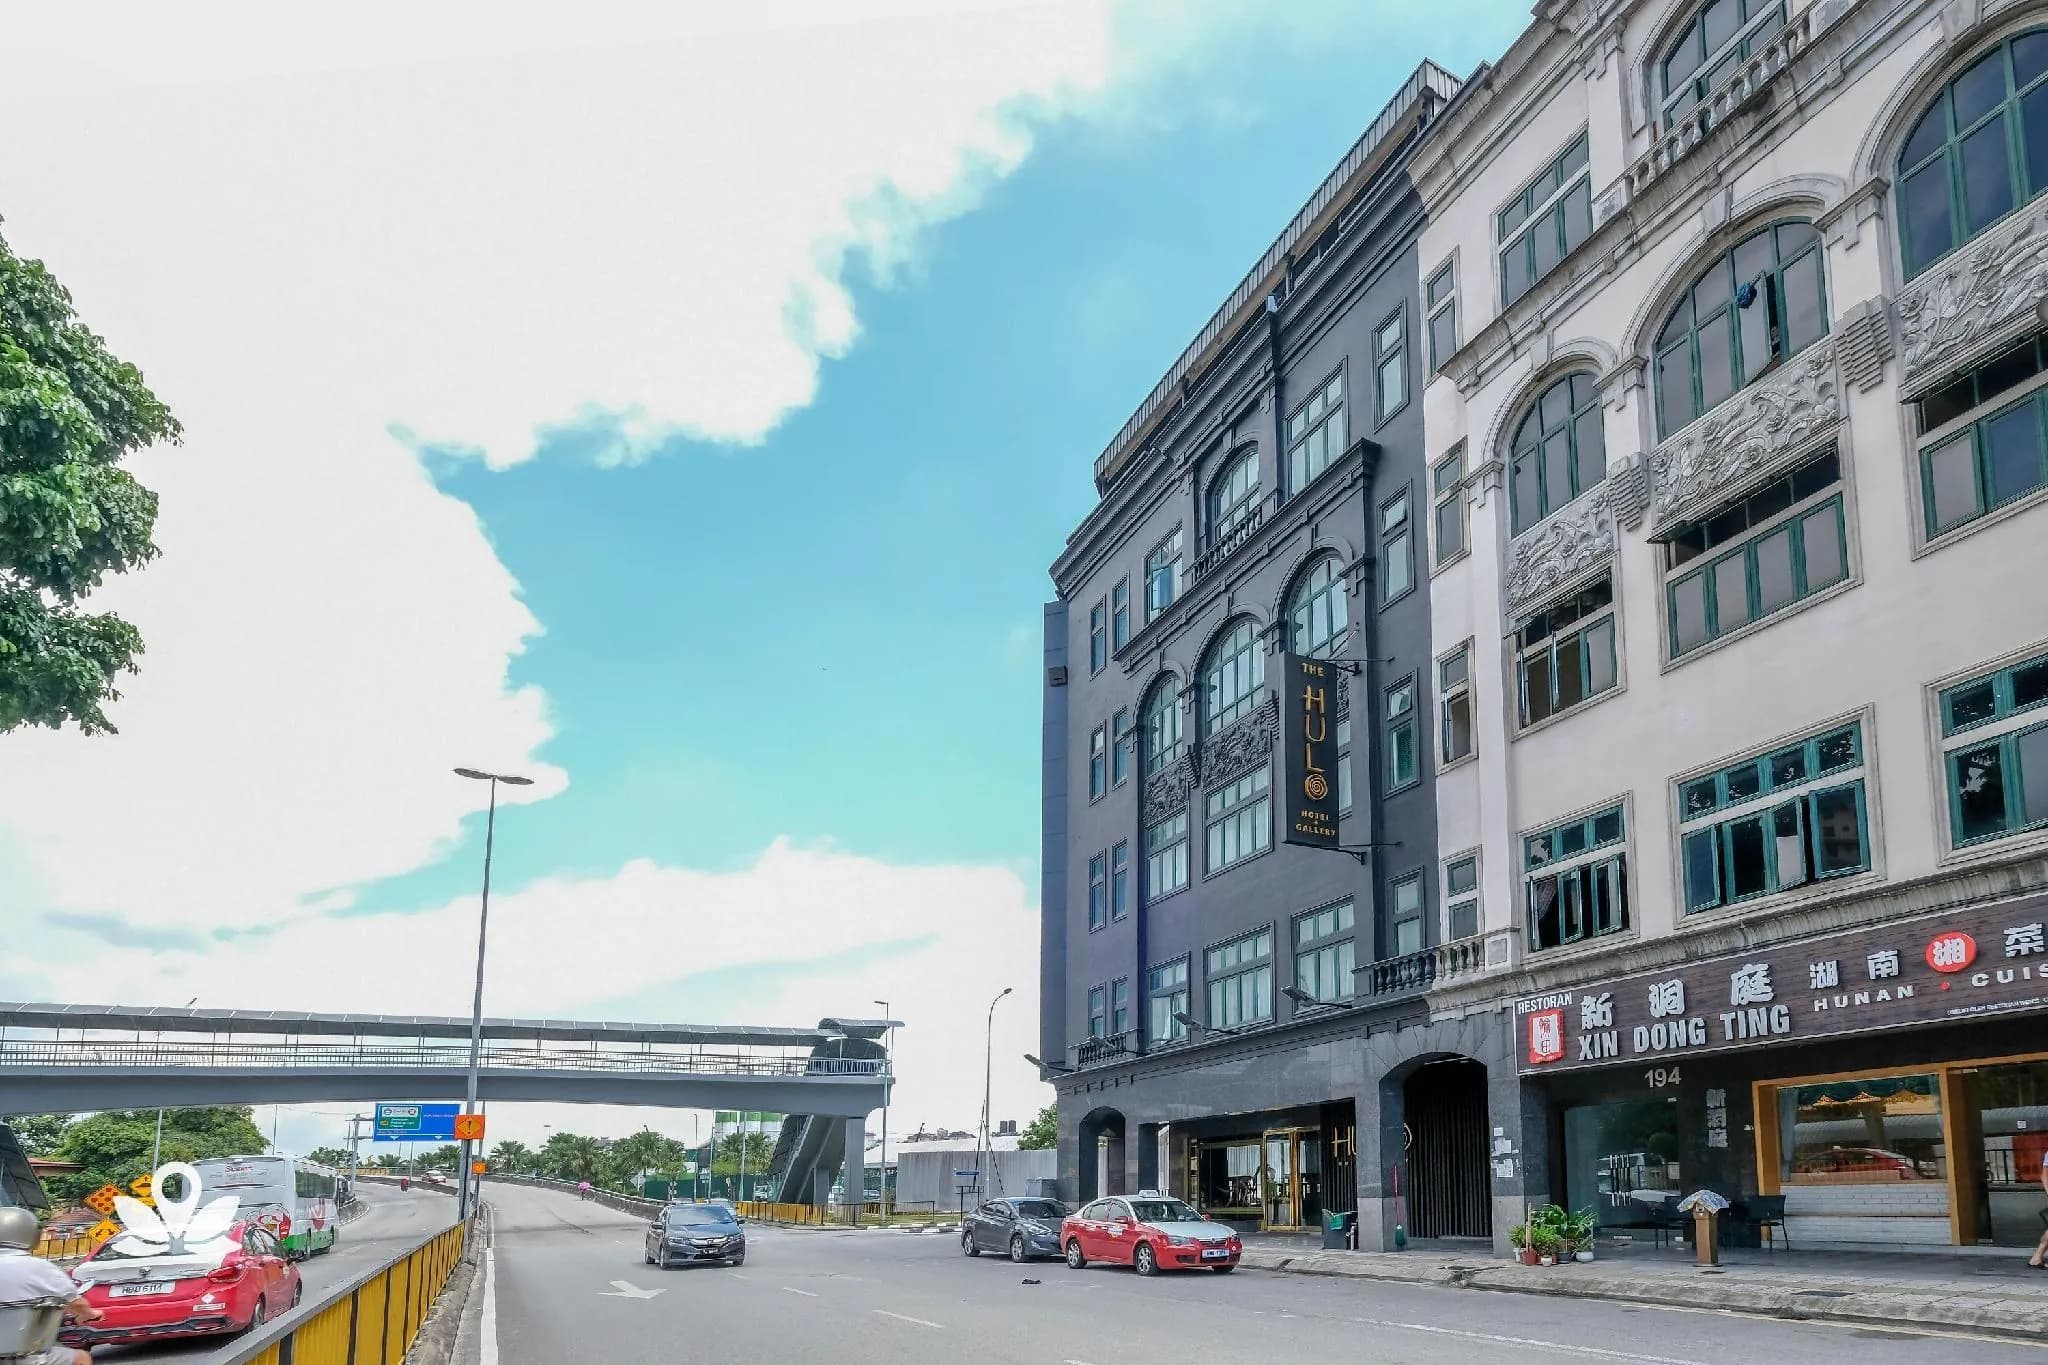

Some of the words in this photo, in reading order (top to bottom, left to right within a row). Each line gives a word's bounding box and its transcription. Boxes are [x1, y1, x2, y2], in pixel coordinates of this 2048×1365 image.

[1302, 662, 1325, 677] THE
[1301, 810, 1329, 821] HOTEL
[1295, 823, 1336, 836] GALLERY
[1518, 991, 1573, 1015] RESTORAN
[1813, 985, 1915, 1012] HUNAN
[1578, 1030, 1618, 1061] XIN
[1633, 1017, 1706, 1053] DONG
[1719, 1004, 1791, 1041] TING
[1644, 1066, 1682, 1088] 194
